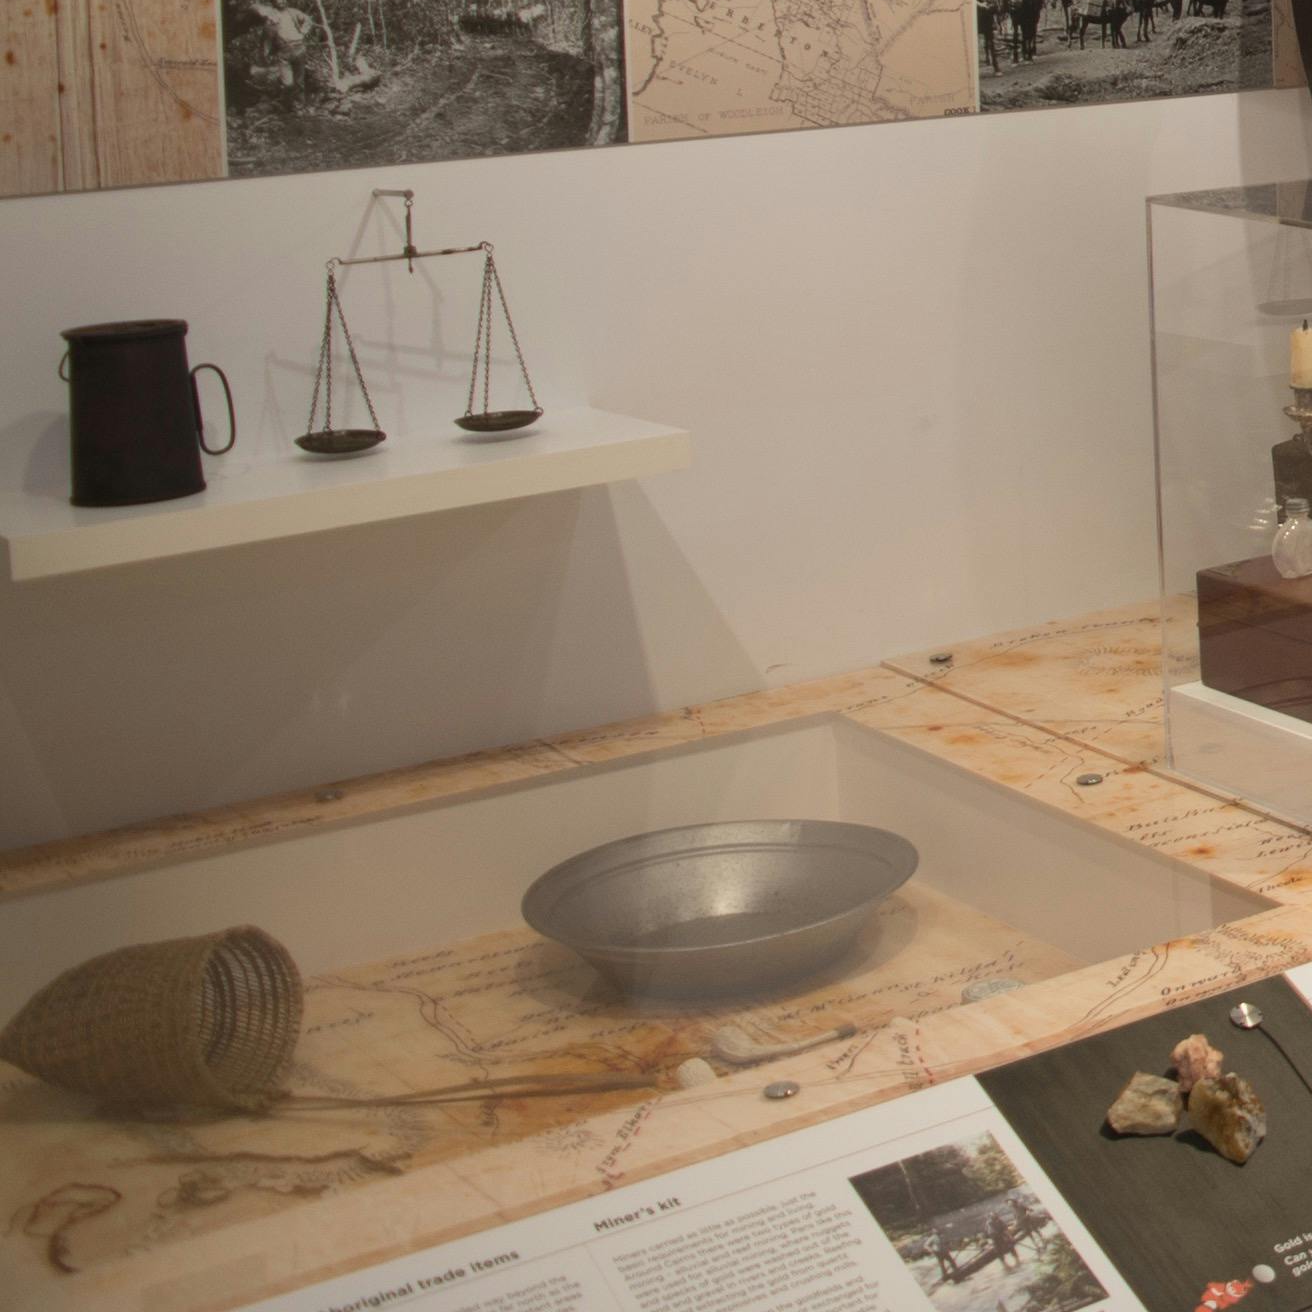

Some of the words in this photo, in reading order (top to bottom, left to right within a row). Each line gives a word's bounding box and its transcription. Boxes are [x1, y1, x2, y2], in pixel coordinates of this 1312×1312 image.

[593, 1205, 655, 1234] Miner's
[657, 1196, 681, 1211] kit
[1273, 1234, 1303, 1253] Gold
[1284, 1250, 1307, 1266] Can
[319, 1282, 412, 1312] boriginal
[418, 1266, 465, 1291] trade
[470, 1249, 520, 1273] items
